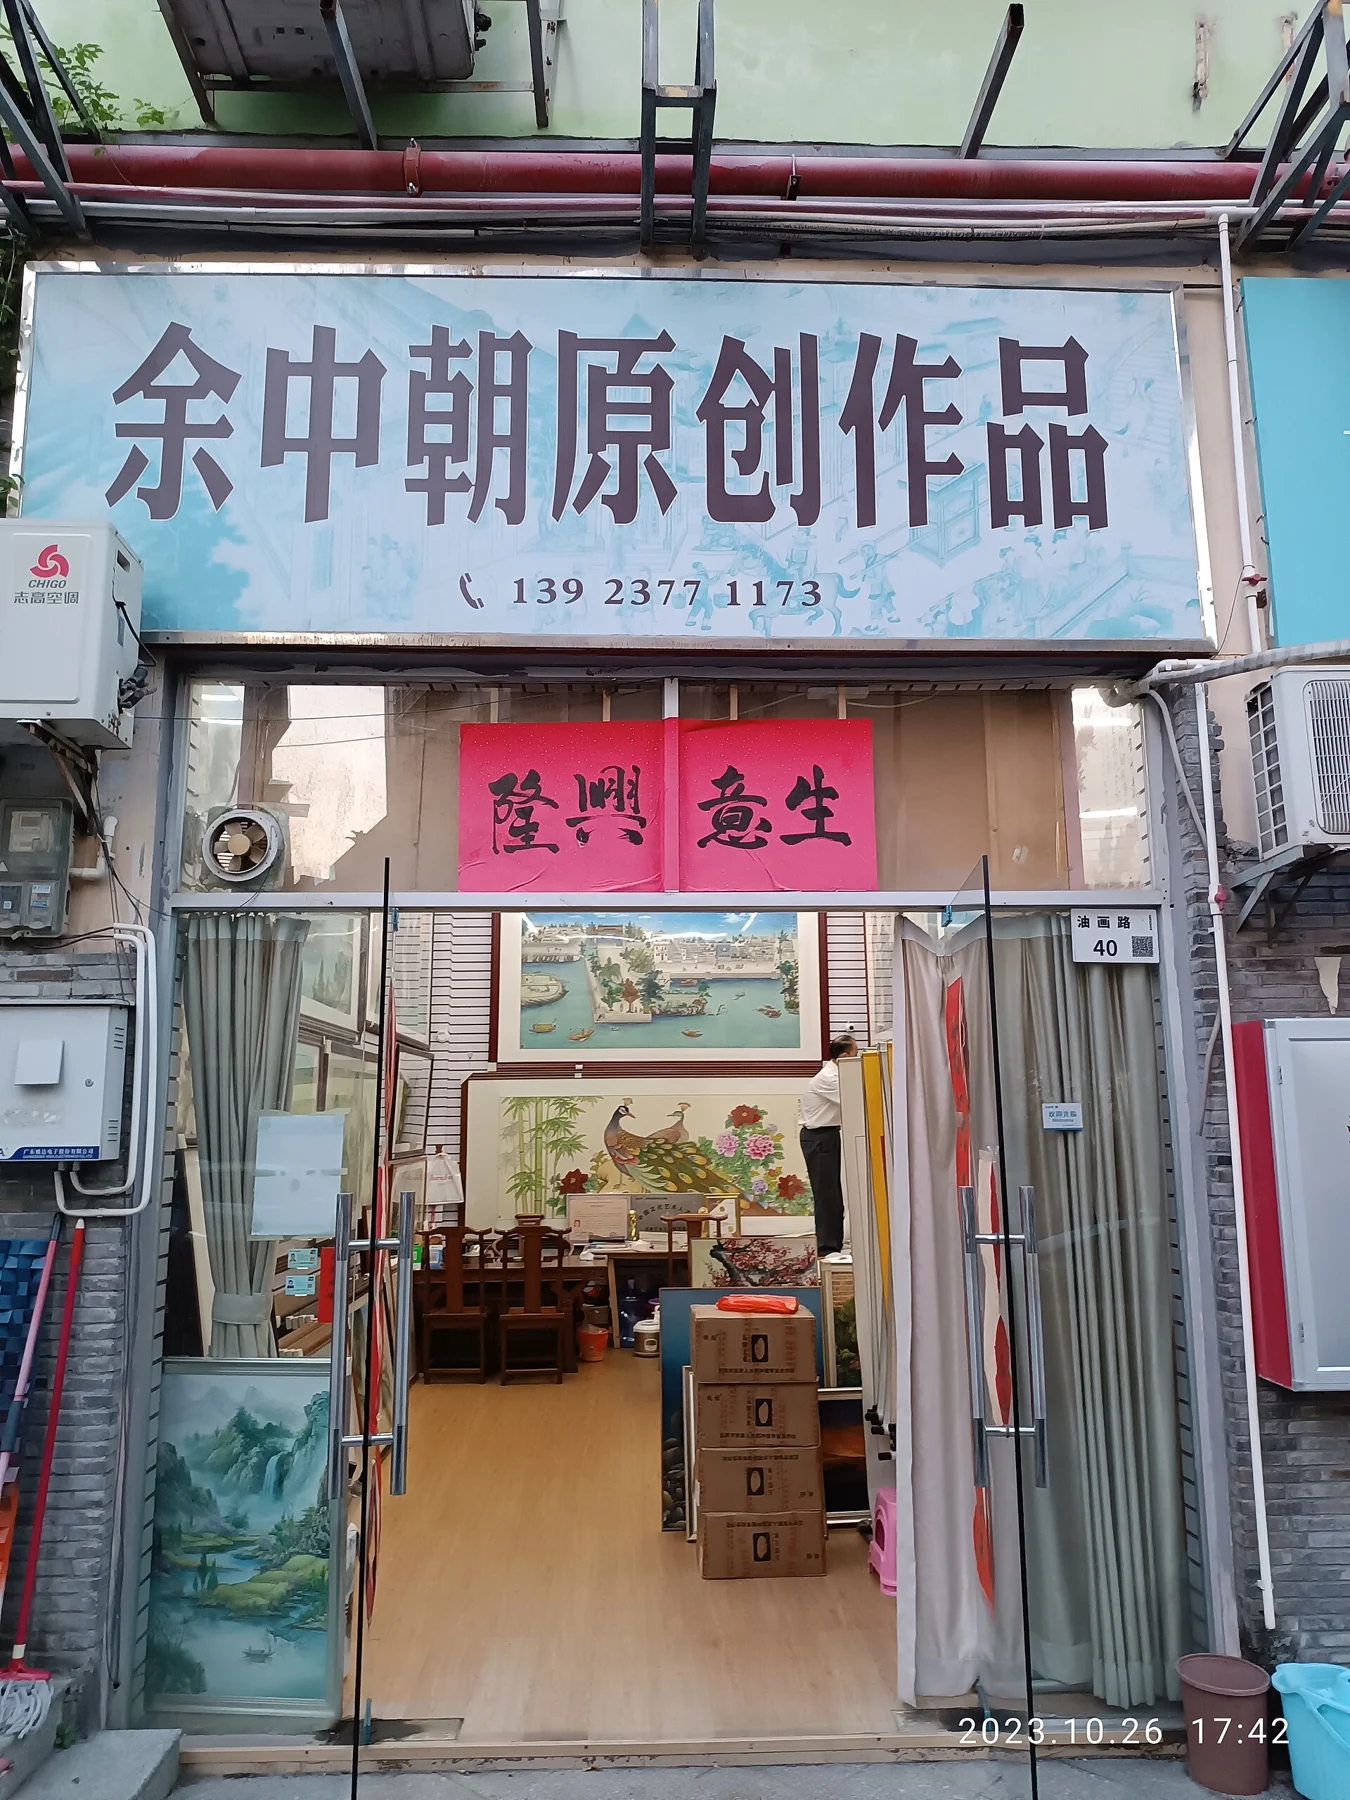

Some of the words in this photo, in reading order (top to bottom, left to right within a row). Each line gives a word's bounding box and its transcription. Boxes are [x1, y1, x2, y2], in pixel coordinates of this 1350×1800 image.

[104, 321, 1110, 532] 余中朝原创作品
[28, 579, 68, 589] CHIGO
[513, 577, 584, 606] 139
[604, 577, 701, 607] 2377
[726, 579, 822, 608] 1173
[13, 591, 80, 605] 志高空调
[1076, 914, 1132, 930] 油画路
[1092, 939, 1119, 958] 40
